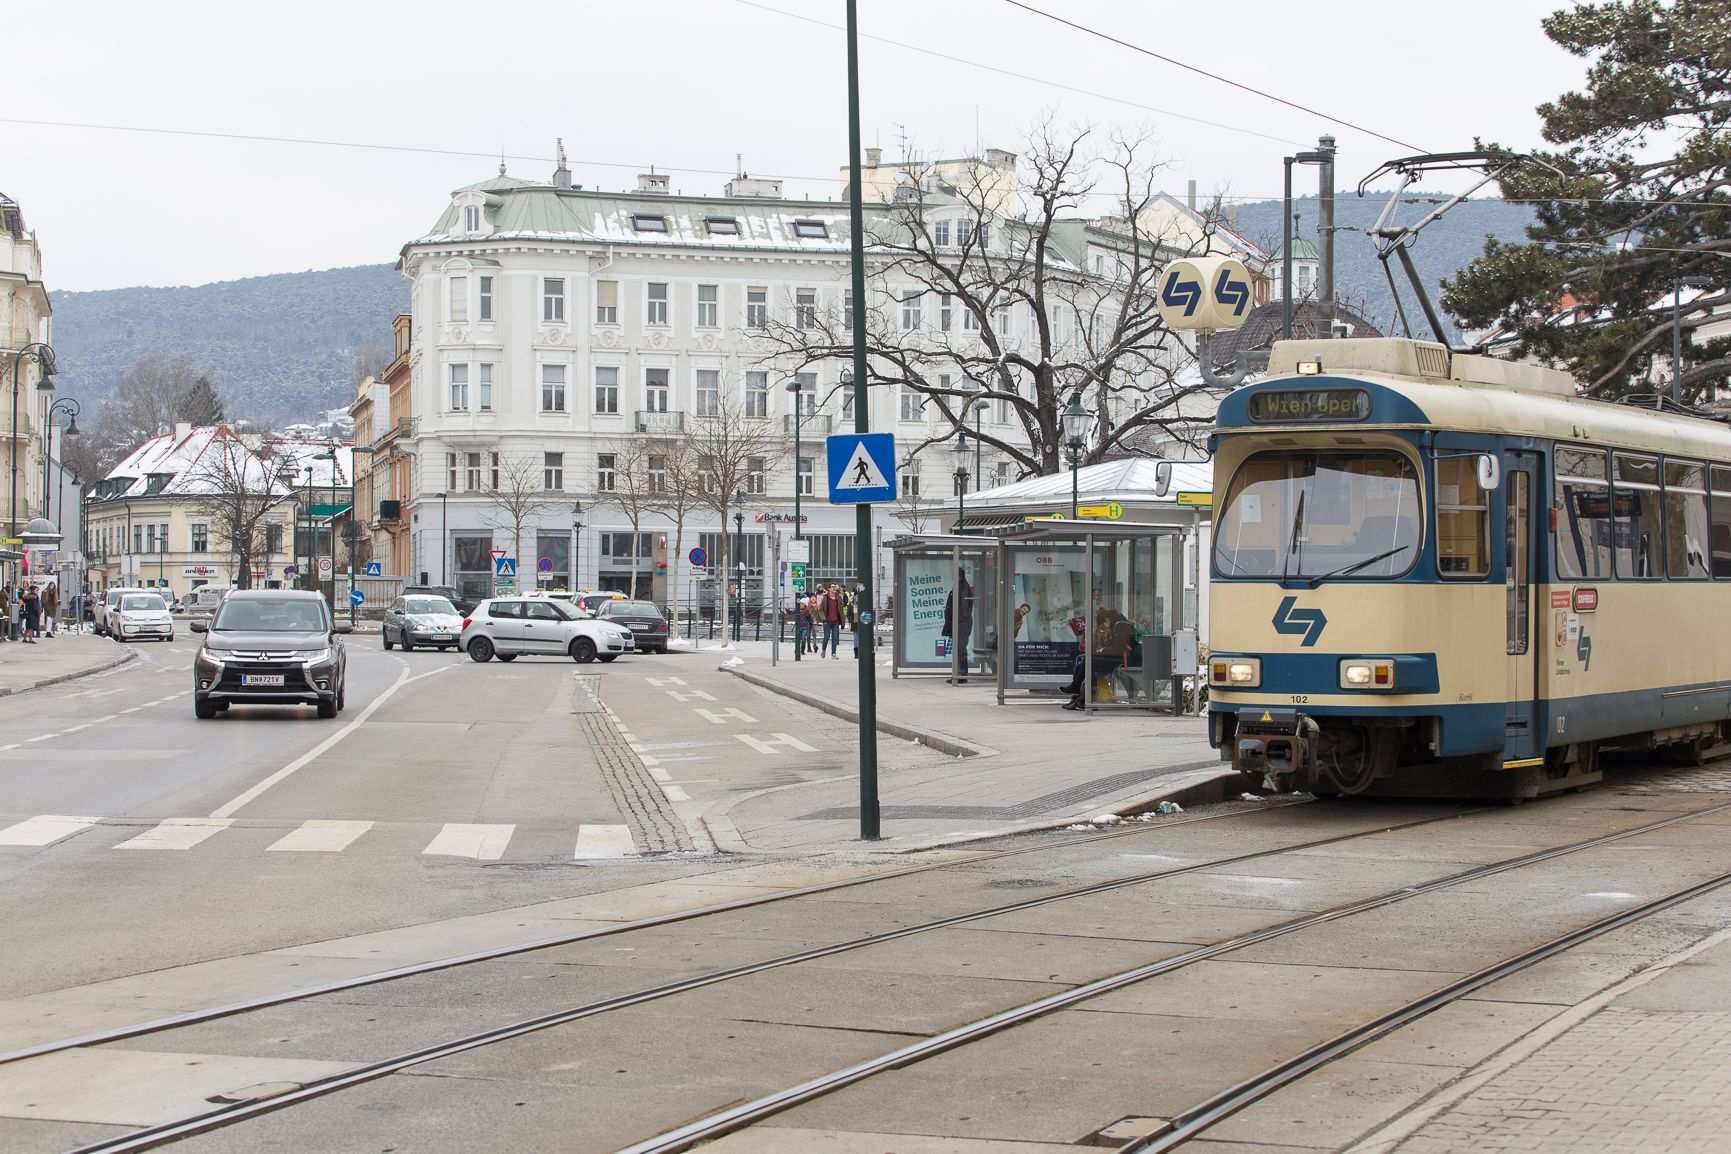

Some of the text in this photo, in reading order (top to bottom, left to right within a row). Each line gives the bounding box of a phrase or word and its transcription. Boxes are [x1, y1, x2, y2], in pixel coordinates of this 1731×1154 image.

[1266, 397, 1312, 413] Wien
[1110, 505, 1118, 516] H
[764, 513, 808, 521] Bank Ausria
[909, 574, 942, 586] Meine
[910, 586, 947, 597] Sonne.
[911, 597, 945, 609] Meine
[1290, 695, 1308, 703] 102
